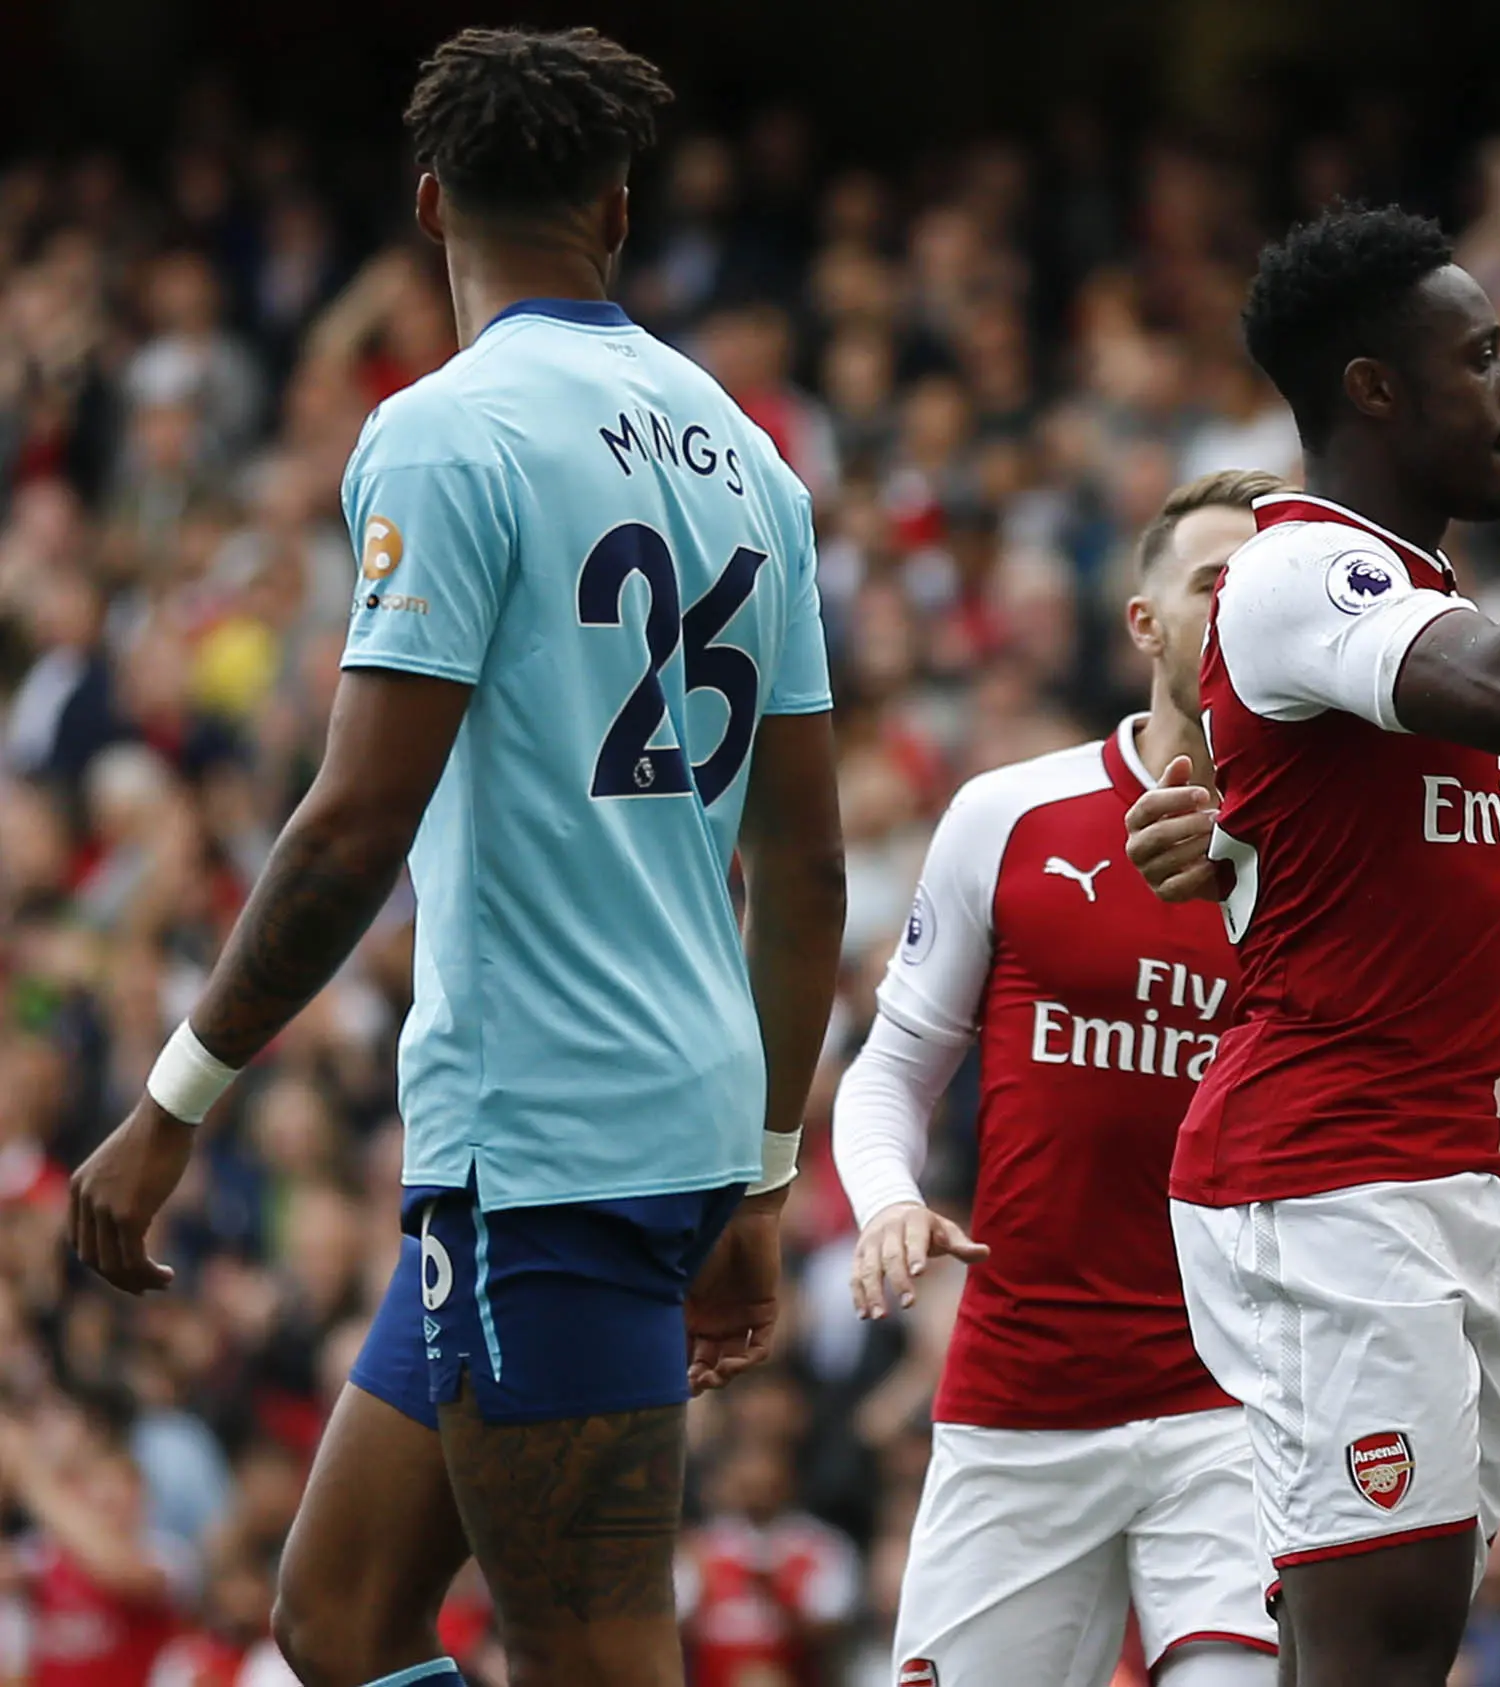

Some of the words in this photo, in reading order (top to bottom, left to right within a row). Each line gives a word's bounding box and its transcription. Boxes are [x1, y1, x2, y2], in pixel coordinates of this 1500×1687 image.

[577, 521, 768, 808] 26
[1137, 957, 1228, 1020] Fly
[421, 1202, 453, 1311] 6
[1354, 1441, 1404, 1465] Arsenal
